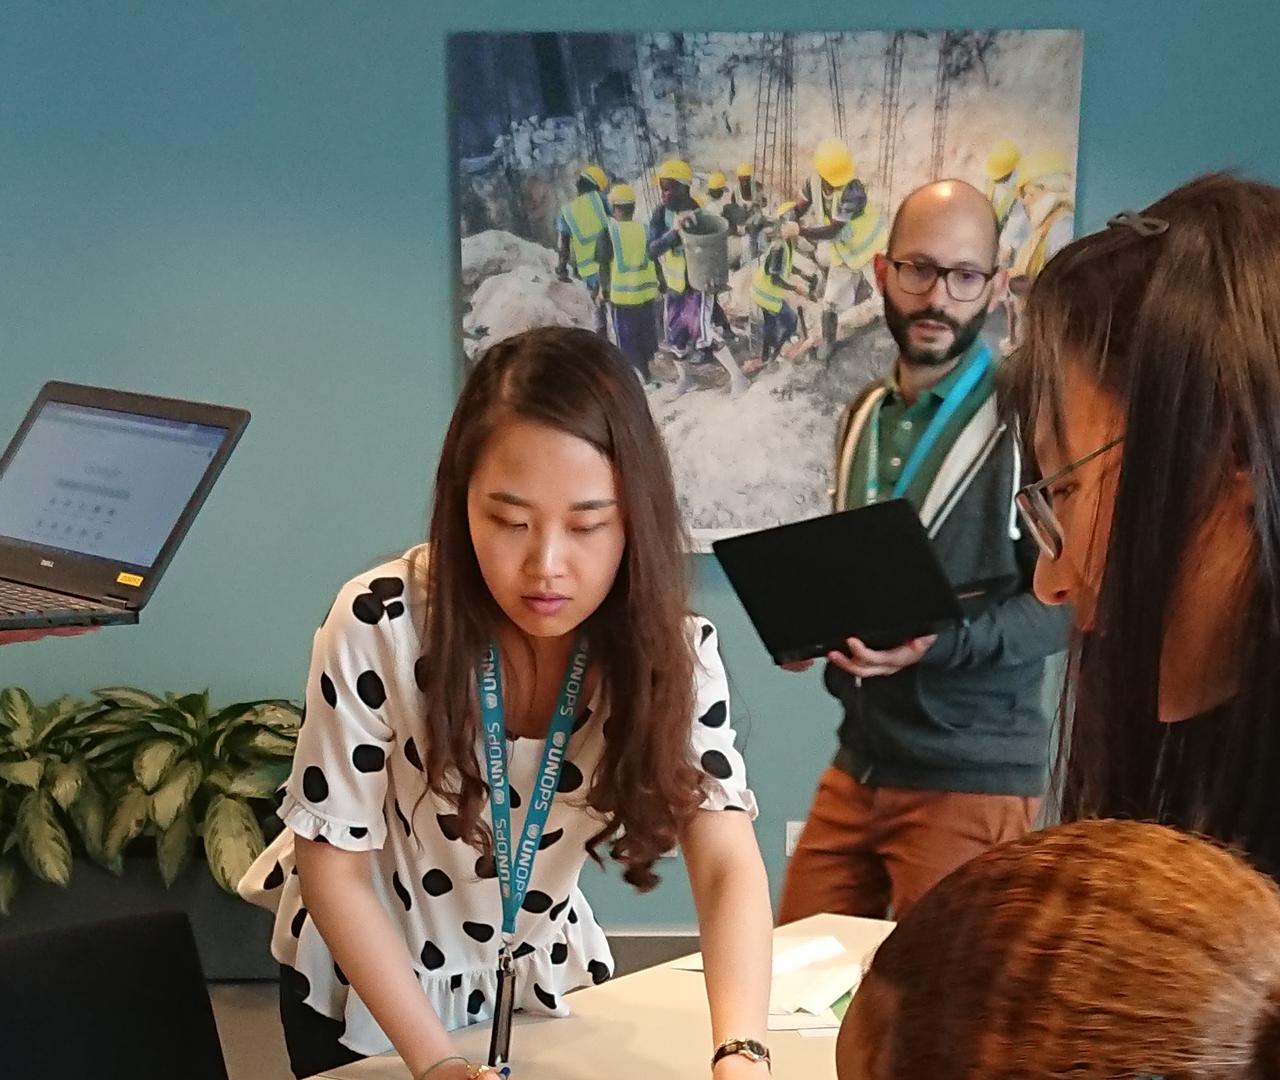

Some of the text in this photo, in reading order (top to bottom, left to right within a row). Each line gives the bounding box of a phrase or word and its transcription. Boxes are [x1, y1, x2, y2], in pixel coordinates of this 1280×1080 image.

[560, 653, 588, 717] UNOPS
[487, 722, 506, 787] UNOPS
[535, 748, 563, 811] UNOPS
[496, 818, 511, 881] UNOPS
[514, 840, 536, 901] UNOPS
